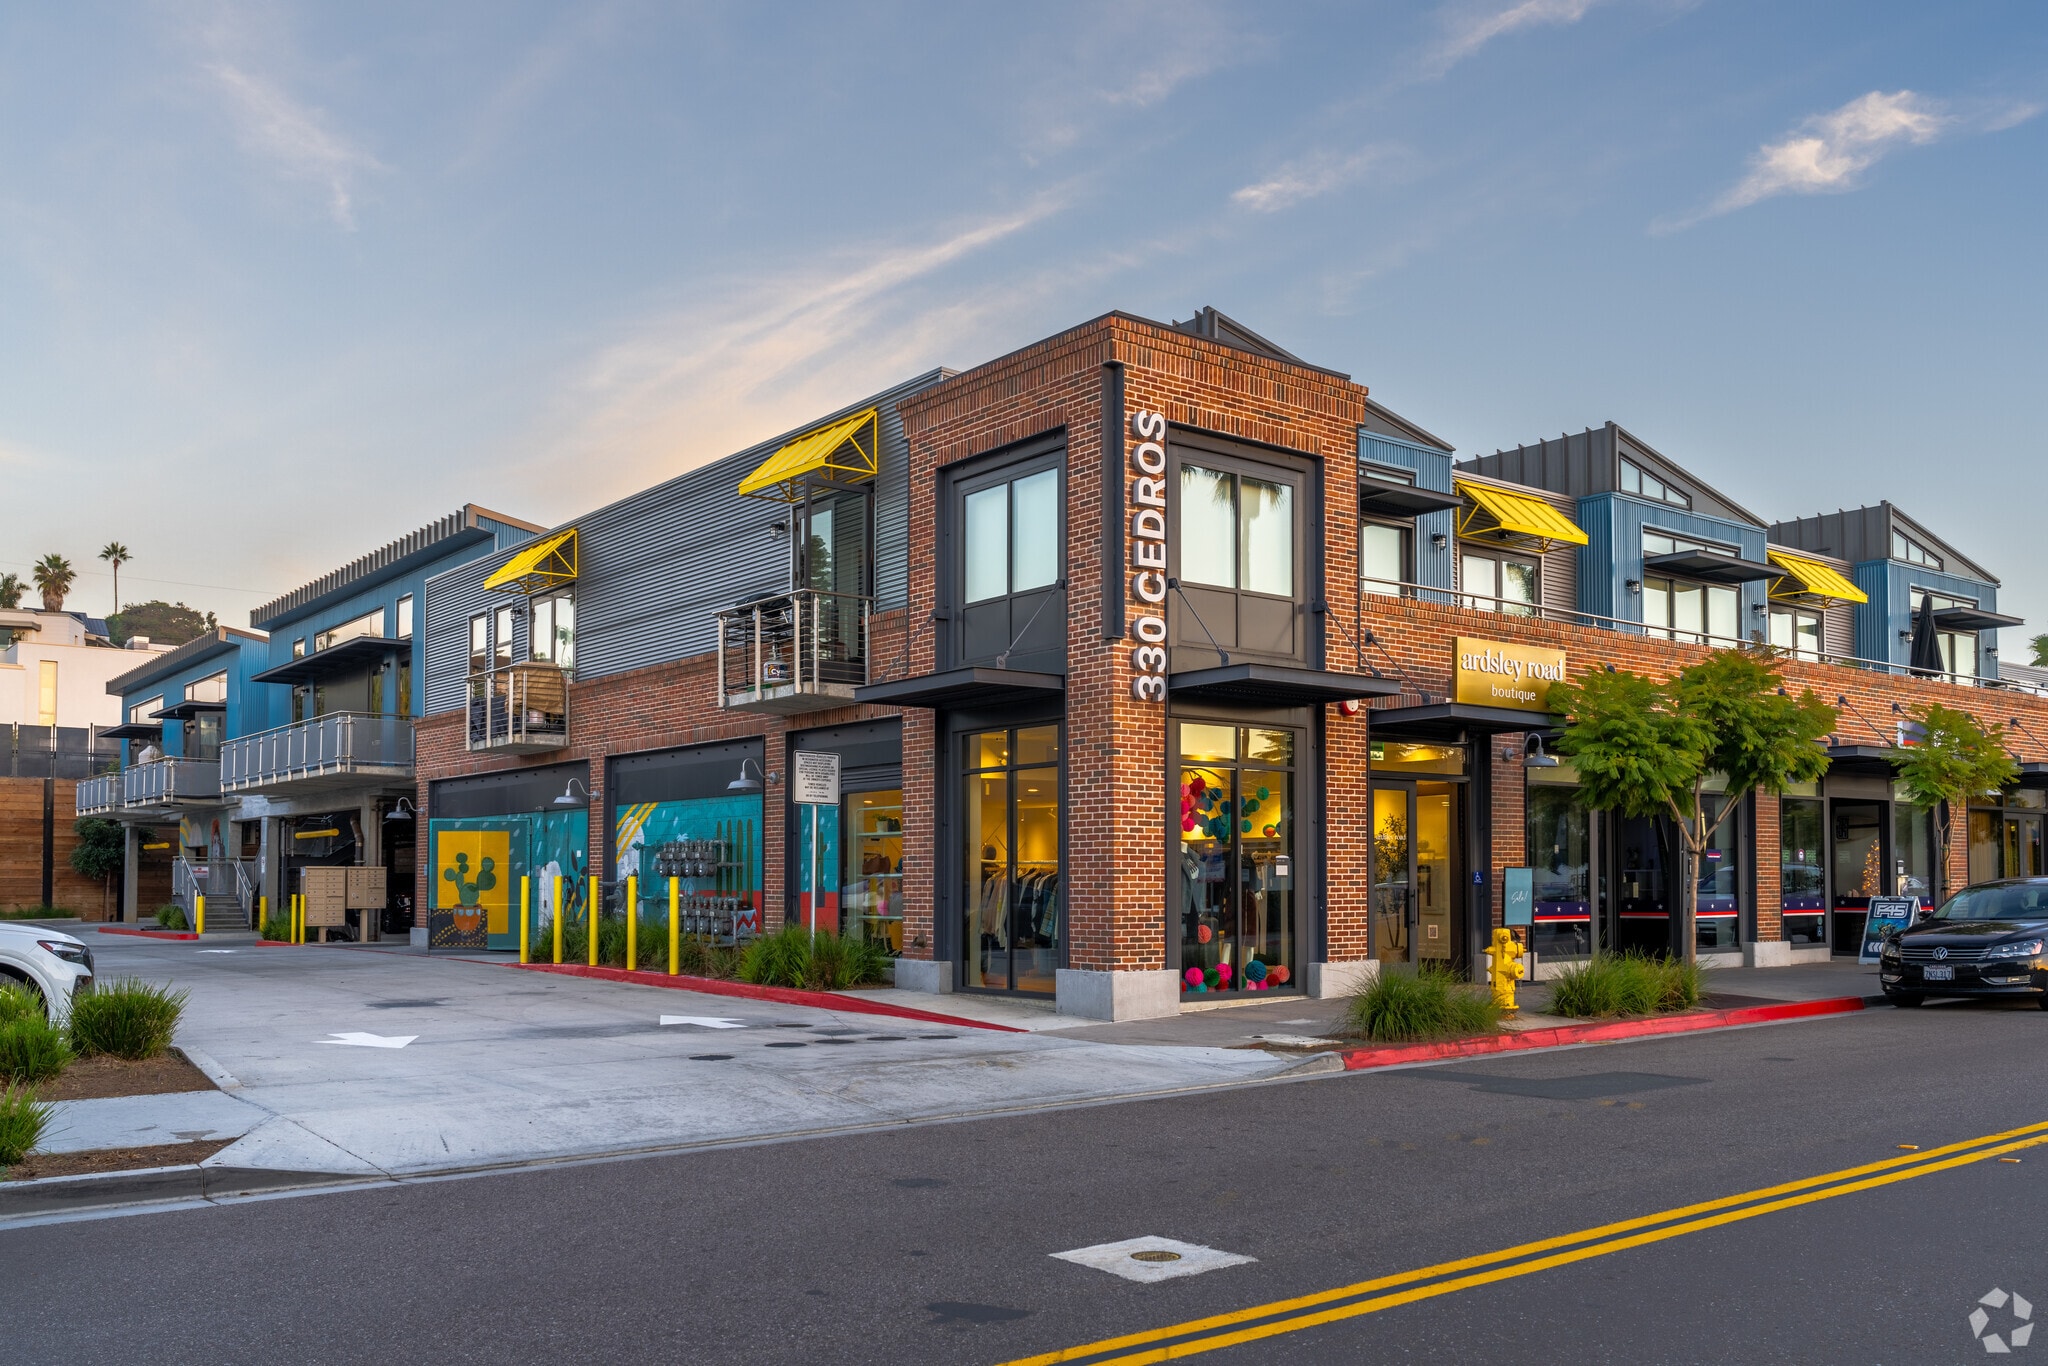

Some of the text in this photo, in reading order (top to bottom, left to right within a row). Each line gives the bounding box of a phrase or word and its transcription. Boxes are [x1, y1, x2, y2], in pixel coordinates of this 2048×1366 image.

[1132, 410, 1166, 702] 330 CEDROS
[1462, 648, 1563, 682] ardsley road
[1491, 684, 1536, 703] boutique
[1875, 903, 1907, 917] F45
